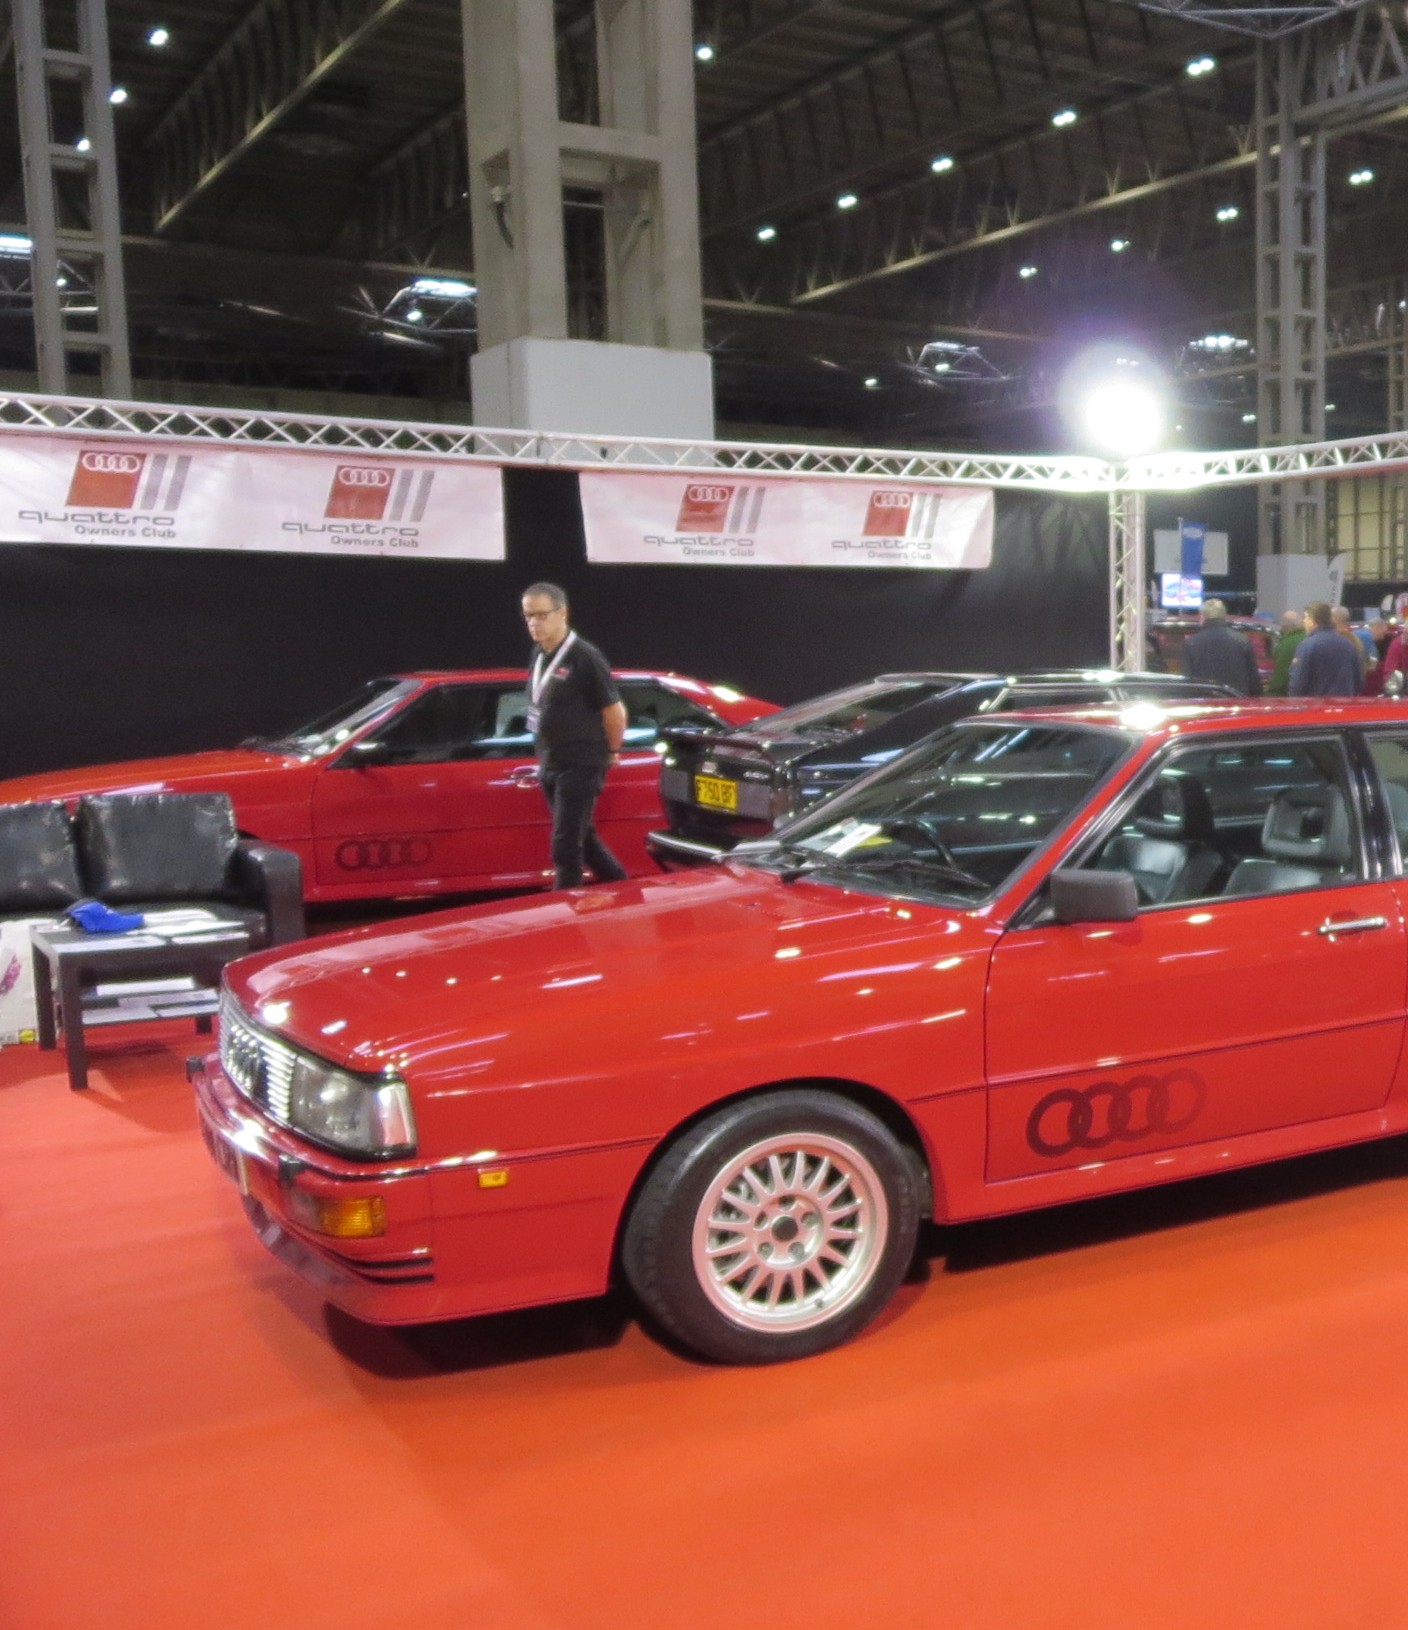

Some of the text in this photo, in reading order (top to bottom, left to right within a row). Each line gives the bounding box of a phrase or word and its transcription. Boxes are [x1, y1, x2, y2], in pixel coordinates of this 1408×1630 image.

[17, 509, 176, 525] quattro
[74, 524, 177, 539] Owners Club
[281, 521, 420, 537] quattro
[330, 535, 420, 549] Owners Club
[643, 535, 755, 547] quattro
[831, 539, 932, 551] quattro
[682, 547, 756, 557] Owners Club
[867, 550, 932, 560] Owners Club
